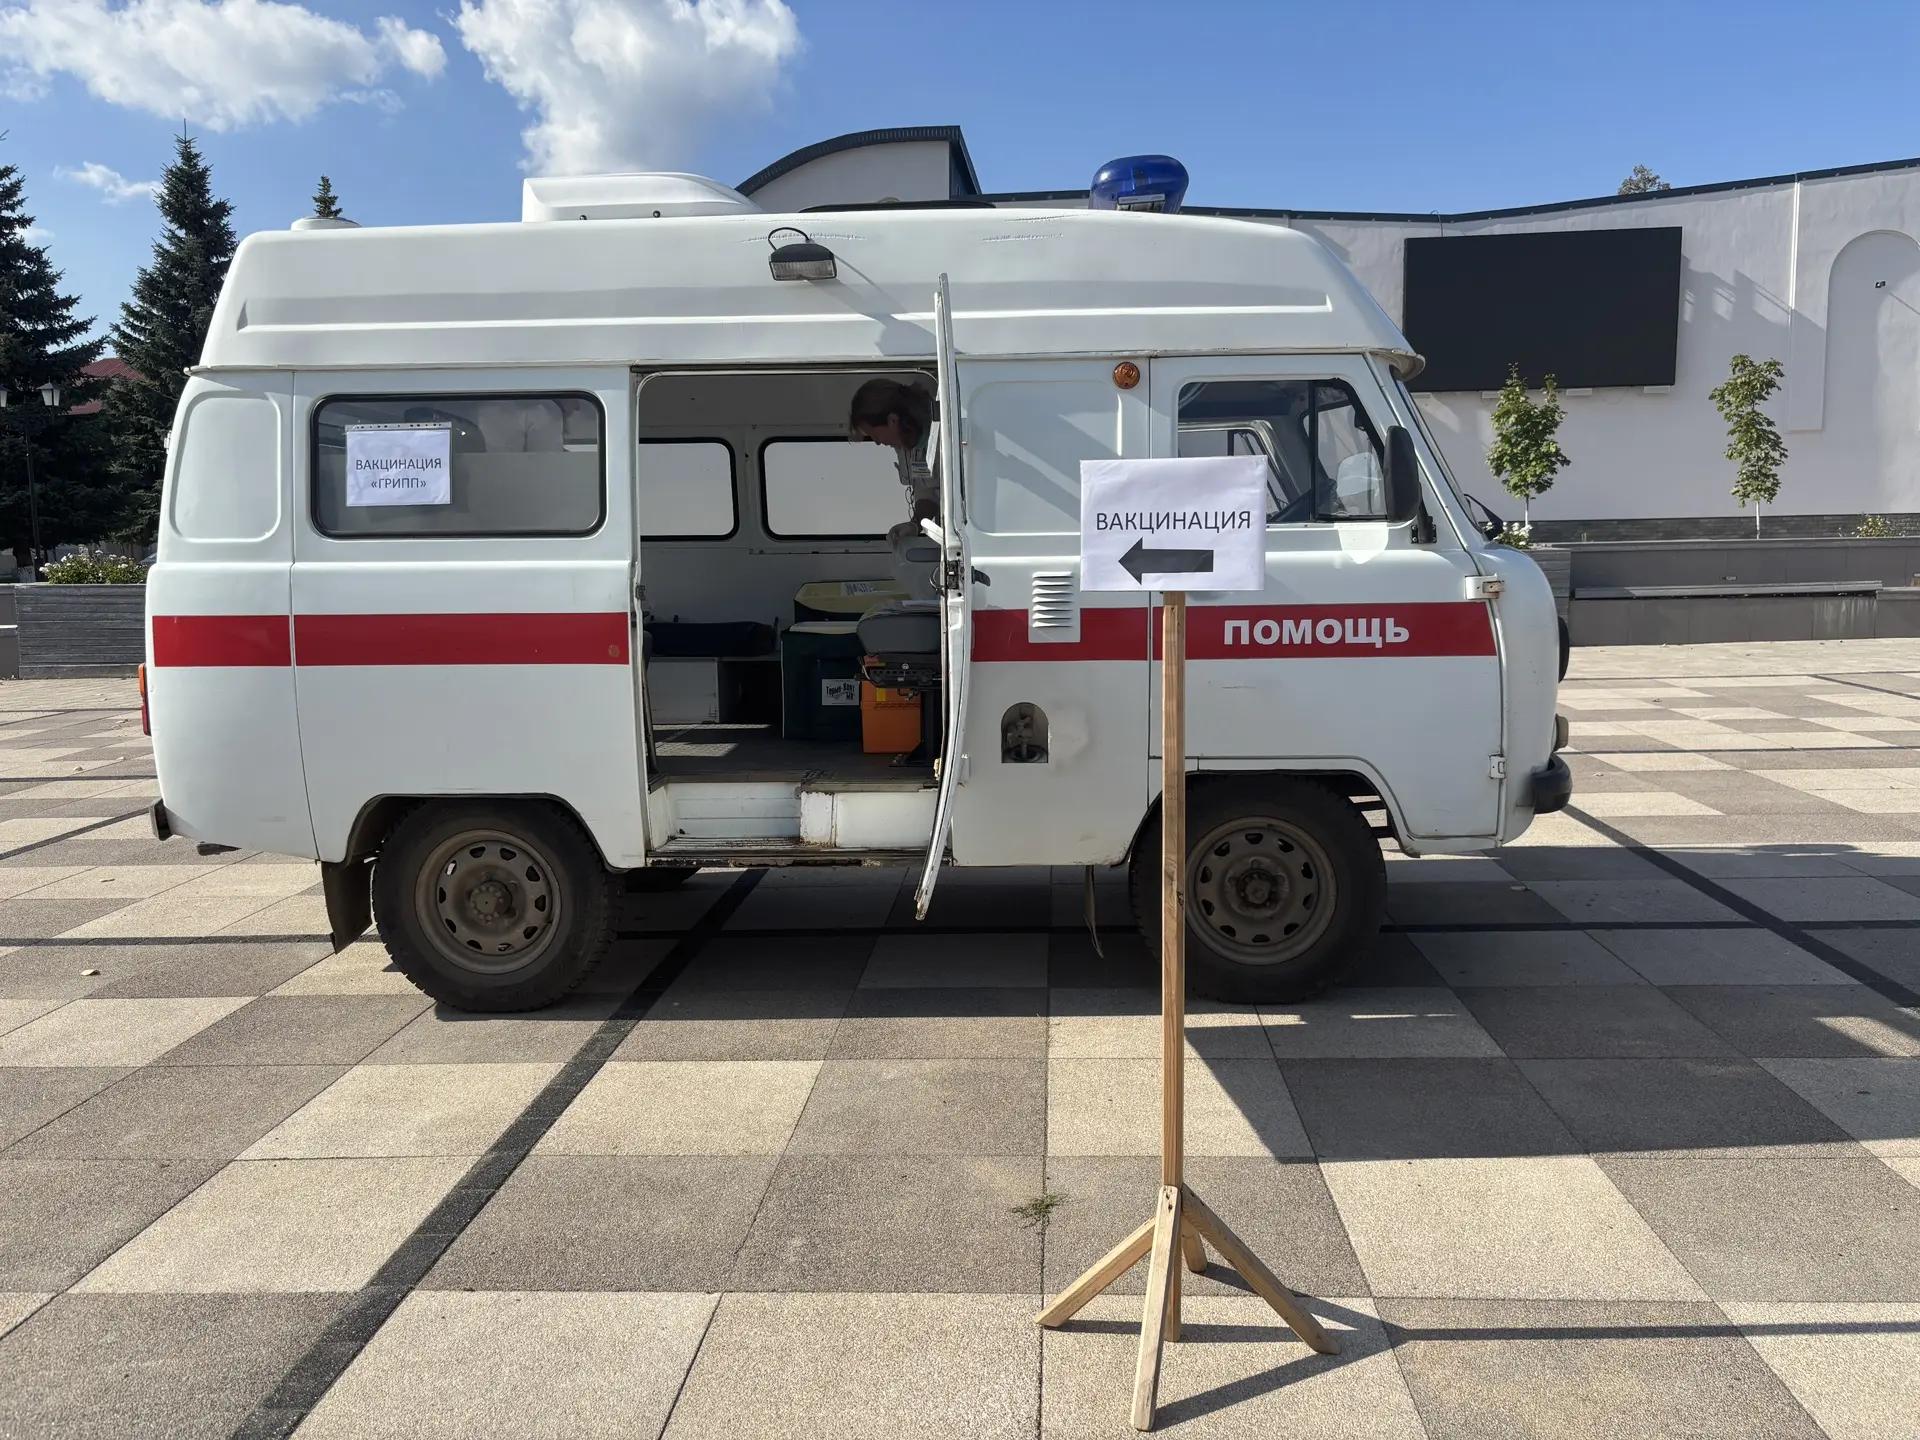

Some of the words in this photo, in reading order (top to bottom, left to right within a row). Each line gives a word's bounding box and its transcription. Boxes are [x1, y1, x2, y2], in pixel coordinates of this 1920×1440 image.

[355, 458, 442, 471] ВАКЦИНАЦИЯ
[371, 477, 427, 489] «ГРИПП»
[1096, 511, 1251, 534] ВАКЦИНАЦИЯ
[1224, 617, 1410, 649] ПОМОЩЬ
